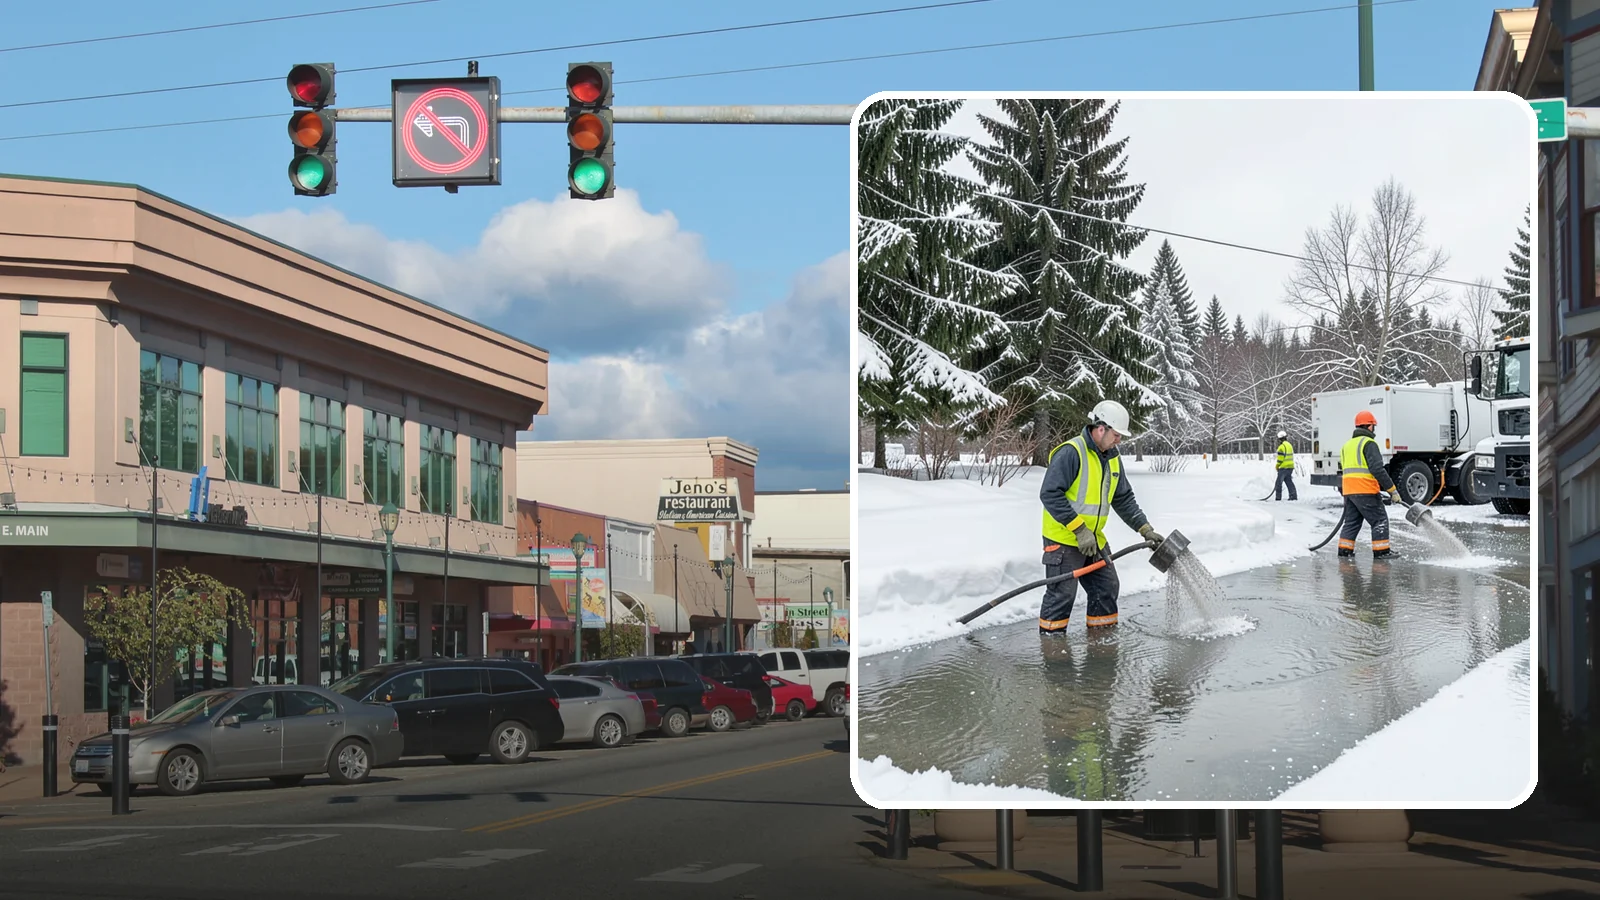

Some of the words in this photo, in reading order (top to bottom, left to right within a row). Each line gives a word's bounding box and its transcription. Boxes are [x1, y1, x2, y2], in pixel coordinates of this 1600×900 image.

[670, 480, 727, 494] Jeno's
[665, 496, 731, 509] restaurant
[658, 509, 681, 519] Italian
[686, 509, 714, 519] American
[715, 509, 737, 519] Cuisine
[2, 525, 13, 536] E.
[15, 525, 49, 536] MAIN
[797, 607, 828, 617] Street
[791, 619, 823, 627] lass
